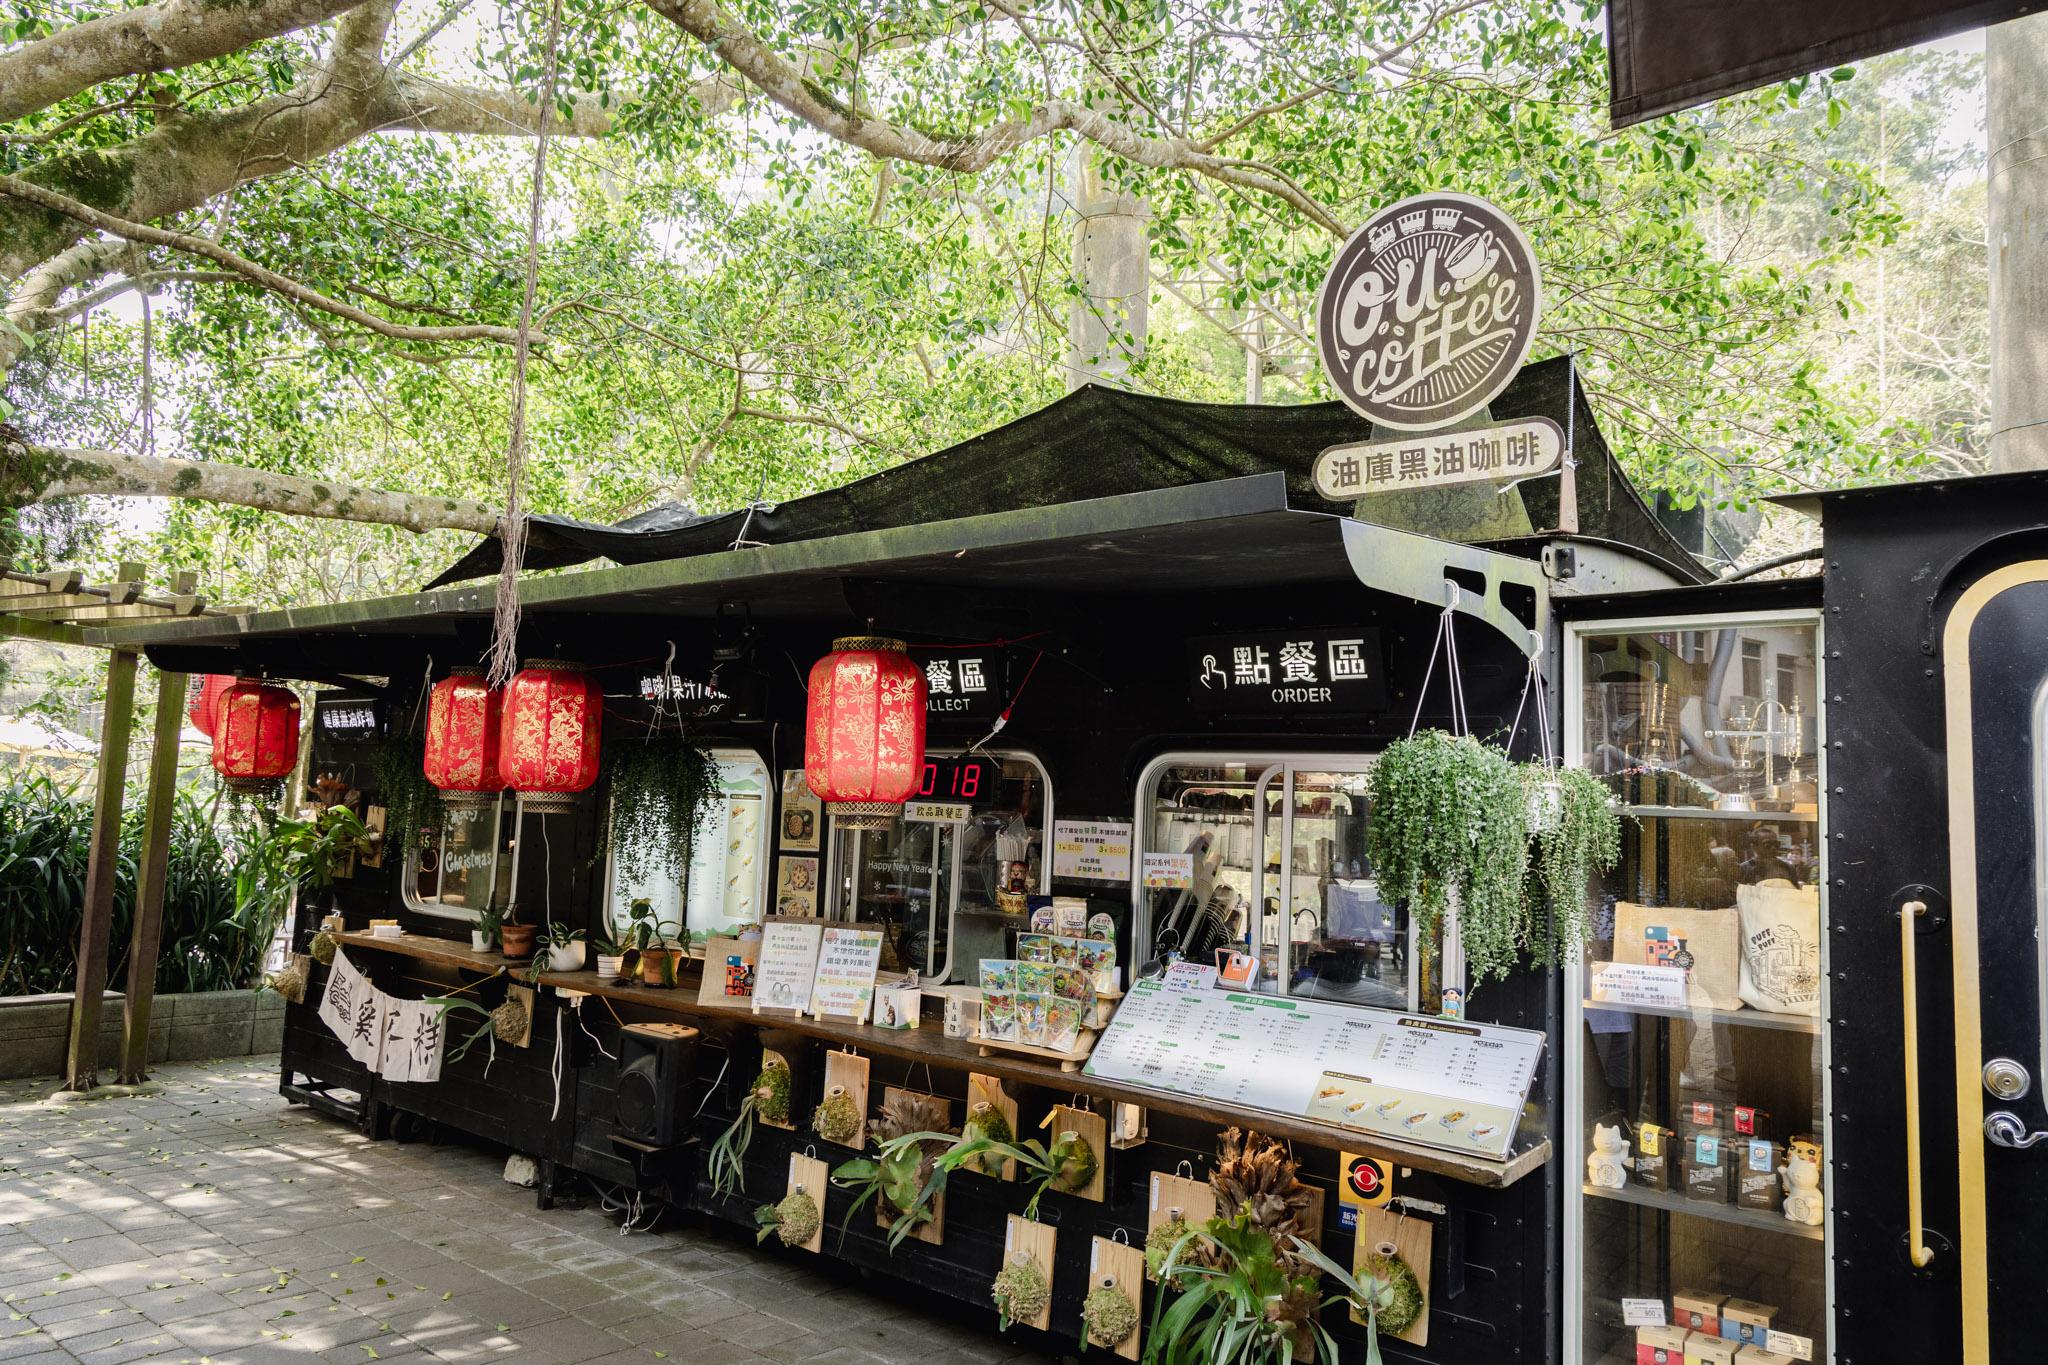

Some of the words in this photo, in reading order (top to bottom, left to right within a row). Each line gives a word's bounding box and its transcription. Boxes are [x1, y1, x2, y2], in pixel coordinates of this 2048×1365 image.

[1331, 431, 1540, 489] 油庫黑油咖啡
[1233, 639, 1368, 685] 點餐區
[1271, 687, 1332, 703] ORDER
[868, 860, 892, 873] Happy
[892, 862, 910, 872] New
[911, 863, 928, 873] Year
